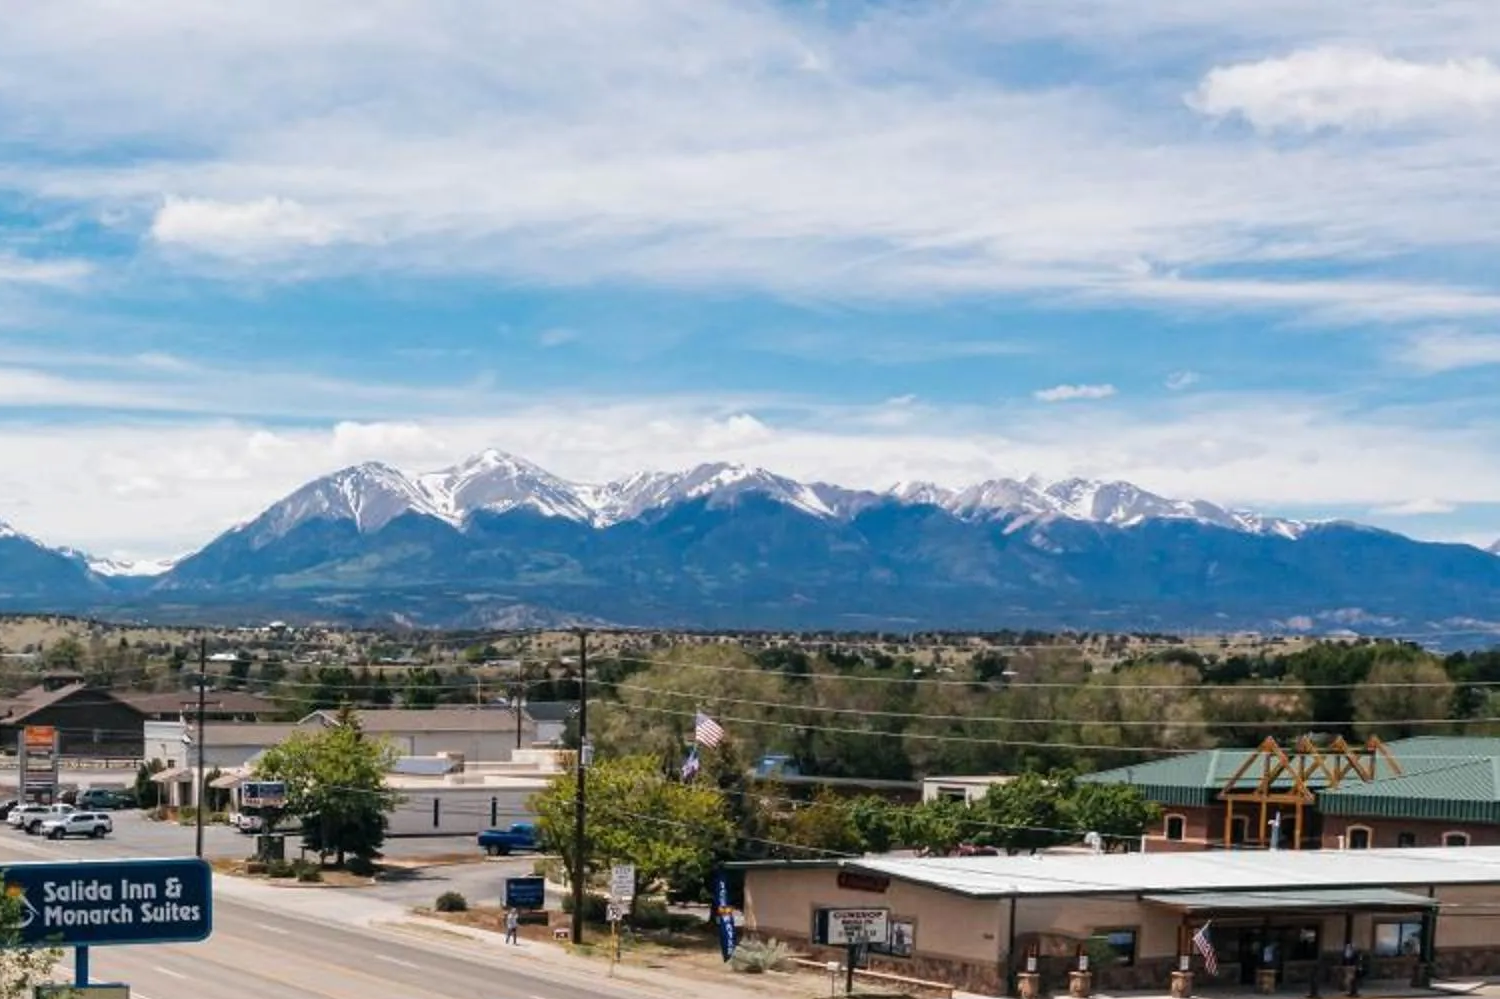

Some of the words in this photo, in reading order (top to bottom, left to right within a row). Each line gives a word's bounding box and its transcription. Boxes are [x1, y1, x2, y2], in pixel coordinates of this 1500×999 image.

[43, 880, 113, 903] Salida
[121, 879, 157, 900] Inn
[165, 877, 183, 899] &
[44, 904, 134, 927] Monarch
[141, 902, 201, 923] Suites
